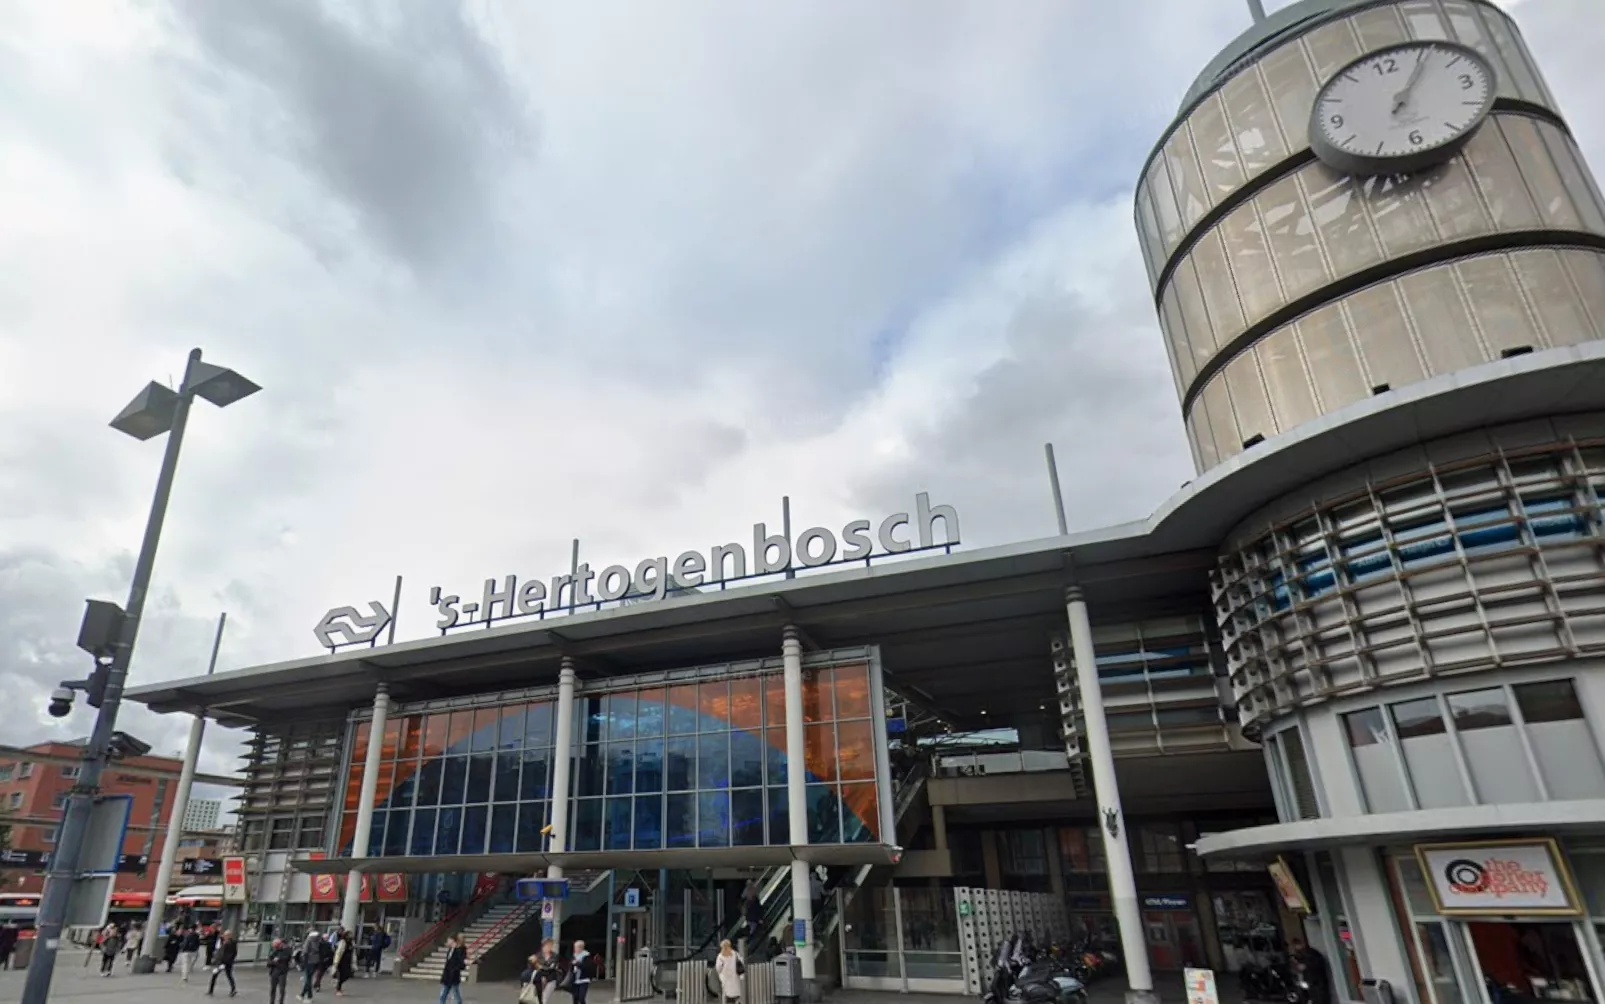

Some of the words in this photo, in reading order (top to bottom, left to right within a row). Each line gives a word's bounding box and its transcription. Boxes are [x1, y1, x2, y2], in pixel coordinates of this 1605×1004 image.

[1373, 59, 1399, 76] 12
[1458, 74, 1474, 90] 3
[1330, 114, 1344, 129] 9
[1408, 129, 1423, 145] 6
[430, 491, 961, 630] 's-Hertogenbosch
